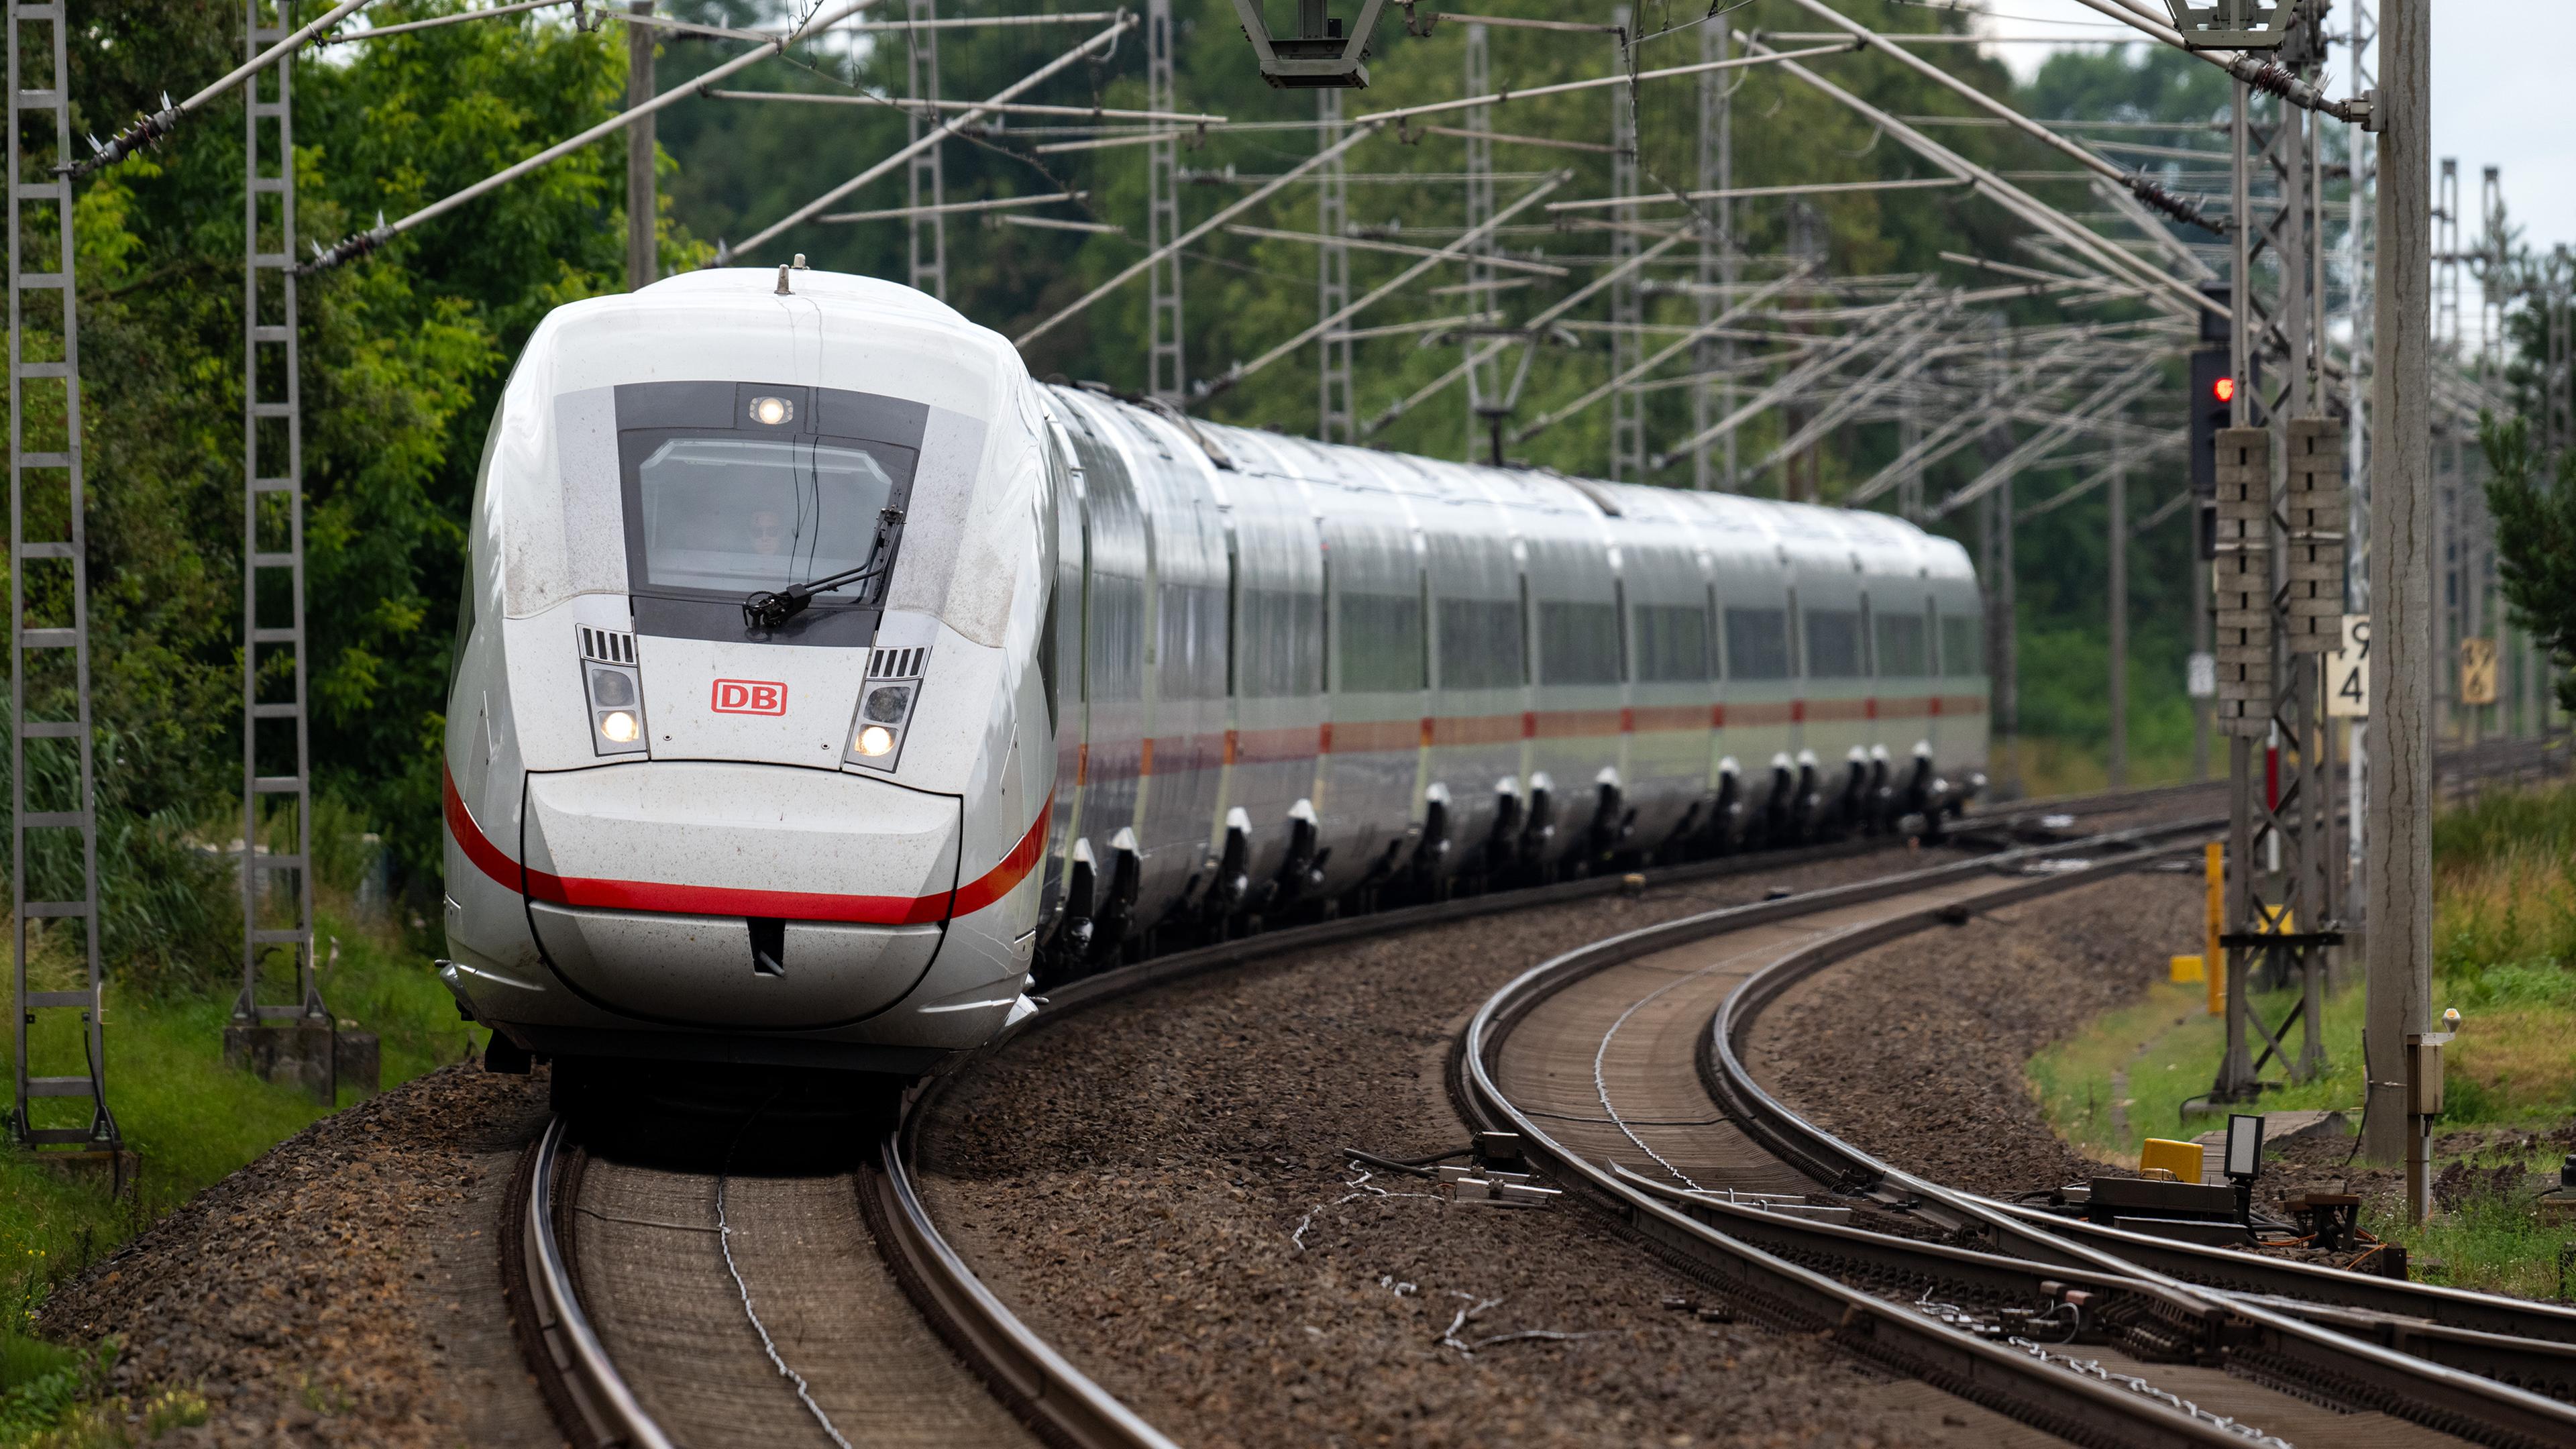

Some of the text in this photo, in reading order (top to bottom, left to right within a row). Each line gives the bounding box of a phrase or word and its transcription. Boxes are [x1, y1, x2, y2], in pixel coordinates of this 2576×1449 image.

[2338, 621, 2370, 659] 9
[721, 684, 777, 710] DB
[2339, 665, 2363, 704] 4
